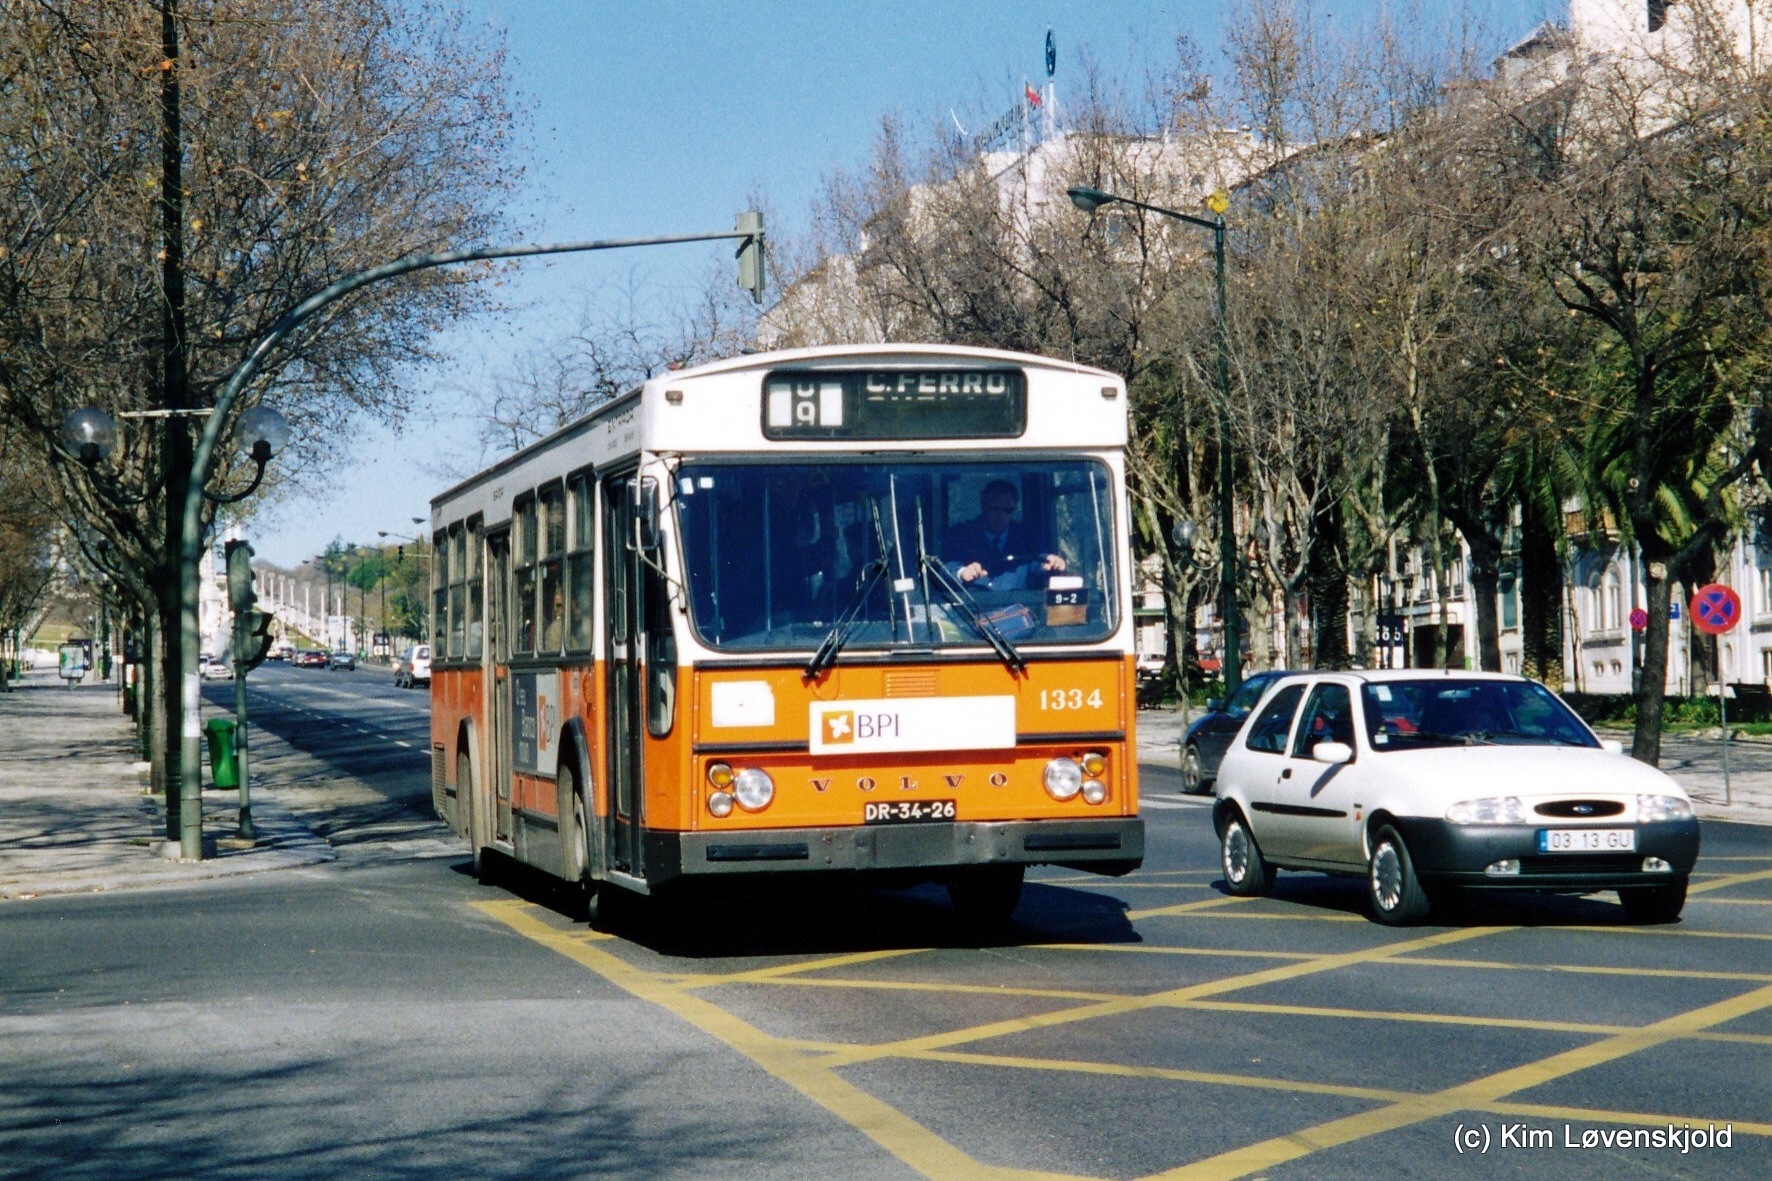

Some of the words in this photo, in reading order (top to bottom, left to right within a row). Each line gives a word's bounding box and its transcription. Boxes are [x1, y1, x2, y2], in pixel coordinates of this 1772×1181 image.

[1055, 593, 1078, 604] 9-2
[1041, 688, 1104, 711] 1334
[857, 713, 899, 739] BPI
[809, 772, 1008, 793] VOLVO
[865, 802, 956, 821] DR-34-26
[1552, 832, 1571, 848] 03
[1583, 832, 1600, 848] 13
[1607, 832, 1630, 848] GU
